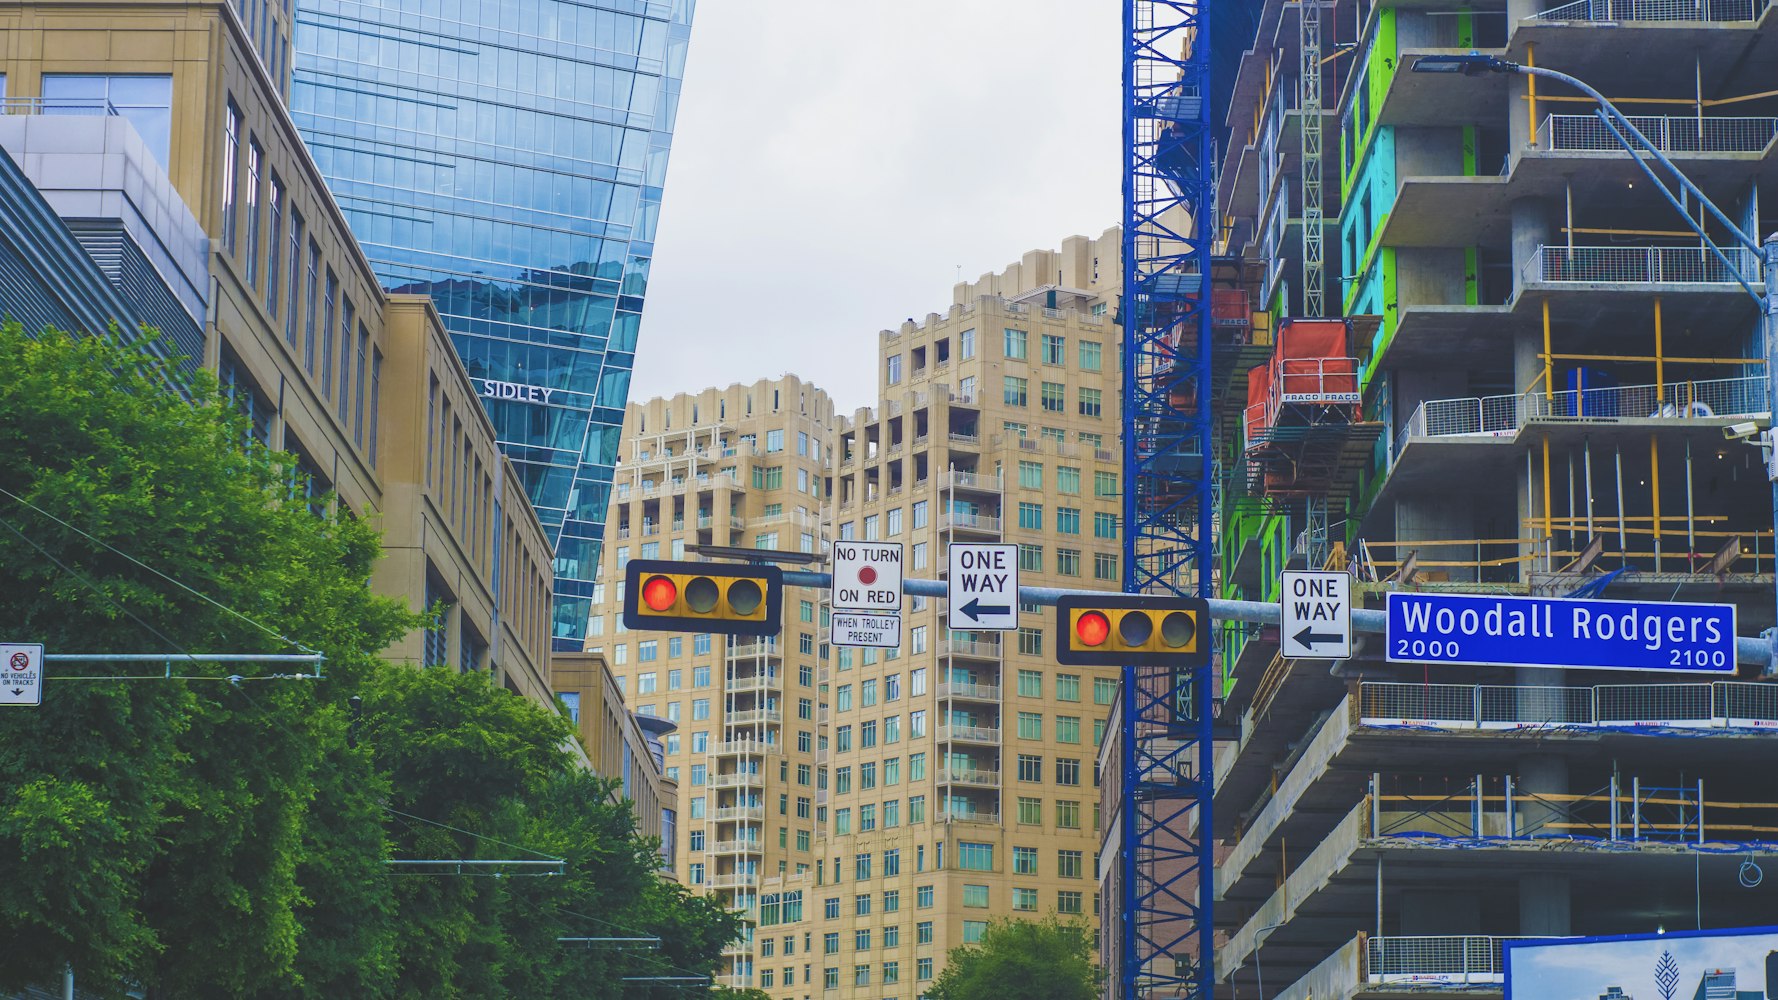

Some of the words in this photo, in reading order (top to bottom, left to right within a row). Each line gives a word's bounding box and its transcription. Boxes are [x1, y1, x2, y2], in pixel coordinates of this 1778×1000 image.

[484, 380, 553, 404] SIDLEY
[837, 548, 856, 561] NO
[862, 549, 899, 562] TURN
[961, 550, 1006, 570] ONE
[961, 574, 1009, 593] WAY
[1293, 578, 1338, 598] ONE
[839, 589, 859, 602] ON
[867, 590, 895, 604] RED
[1294, 602, 1341, 621] WAY
[837, 617, 858, 629] WHEN
[862, 618, 895, 630] TROLLEY
[1401, 601, 1554, 638] Woodall
[1572, 607, 1722, 651] Rodgers
[848, 631, 883, 643] PRESENT
[1397, 639, 1460, 658] 2000
[1669, 649, 1726, 667] 2100
